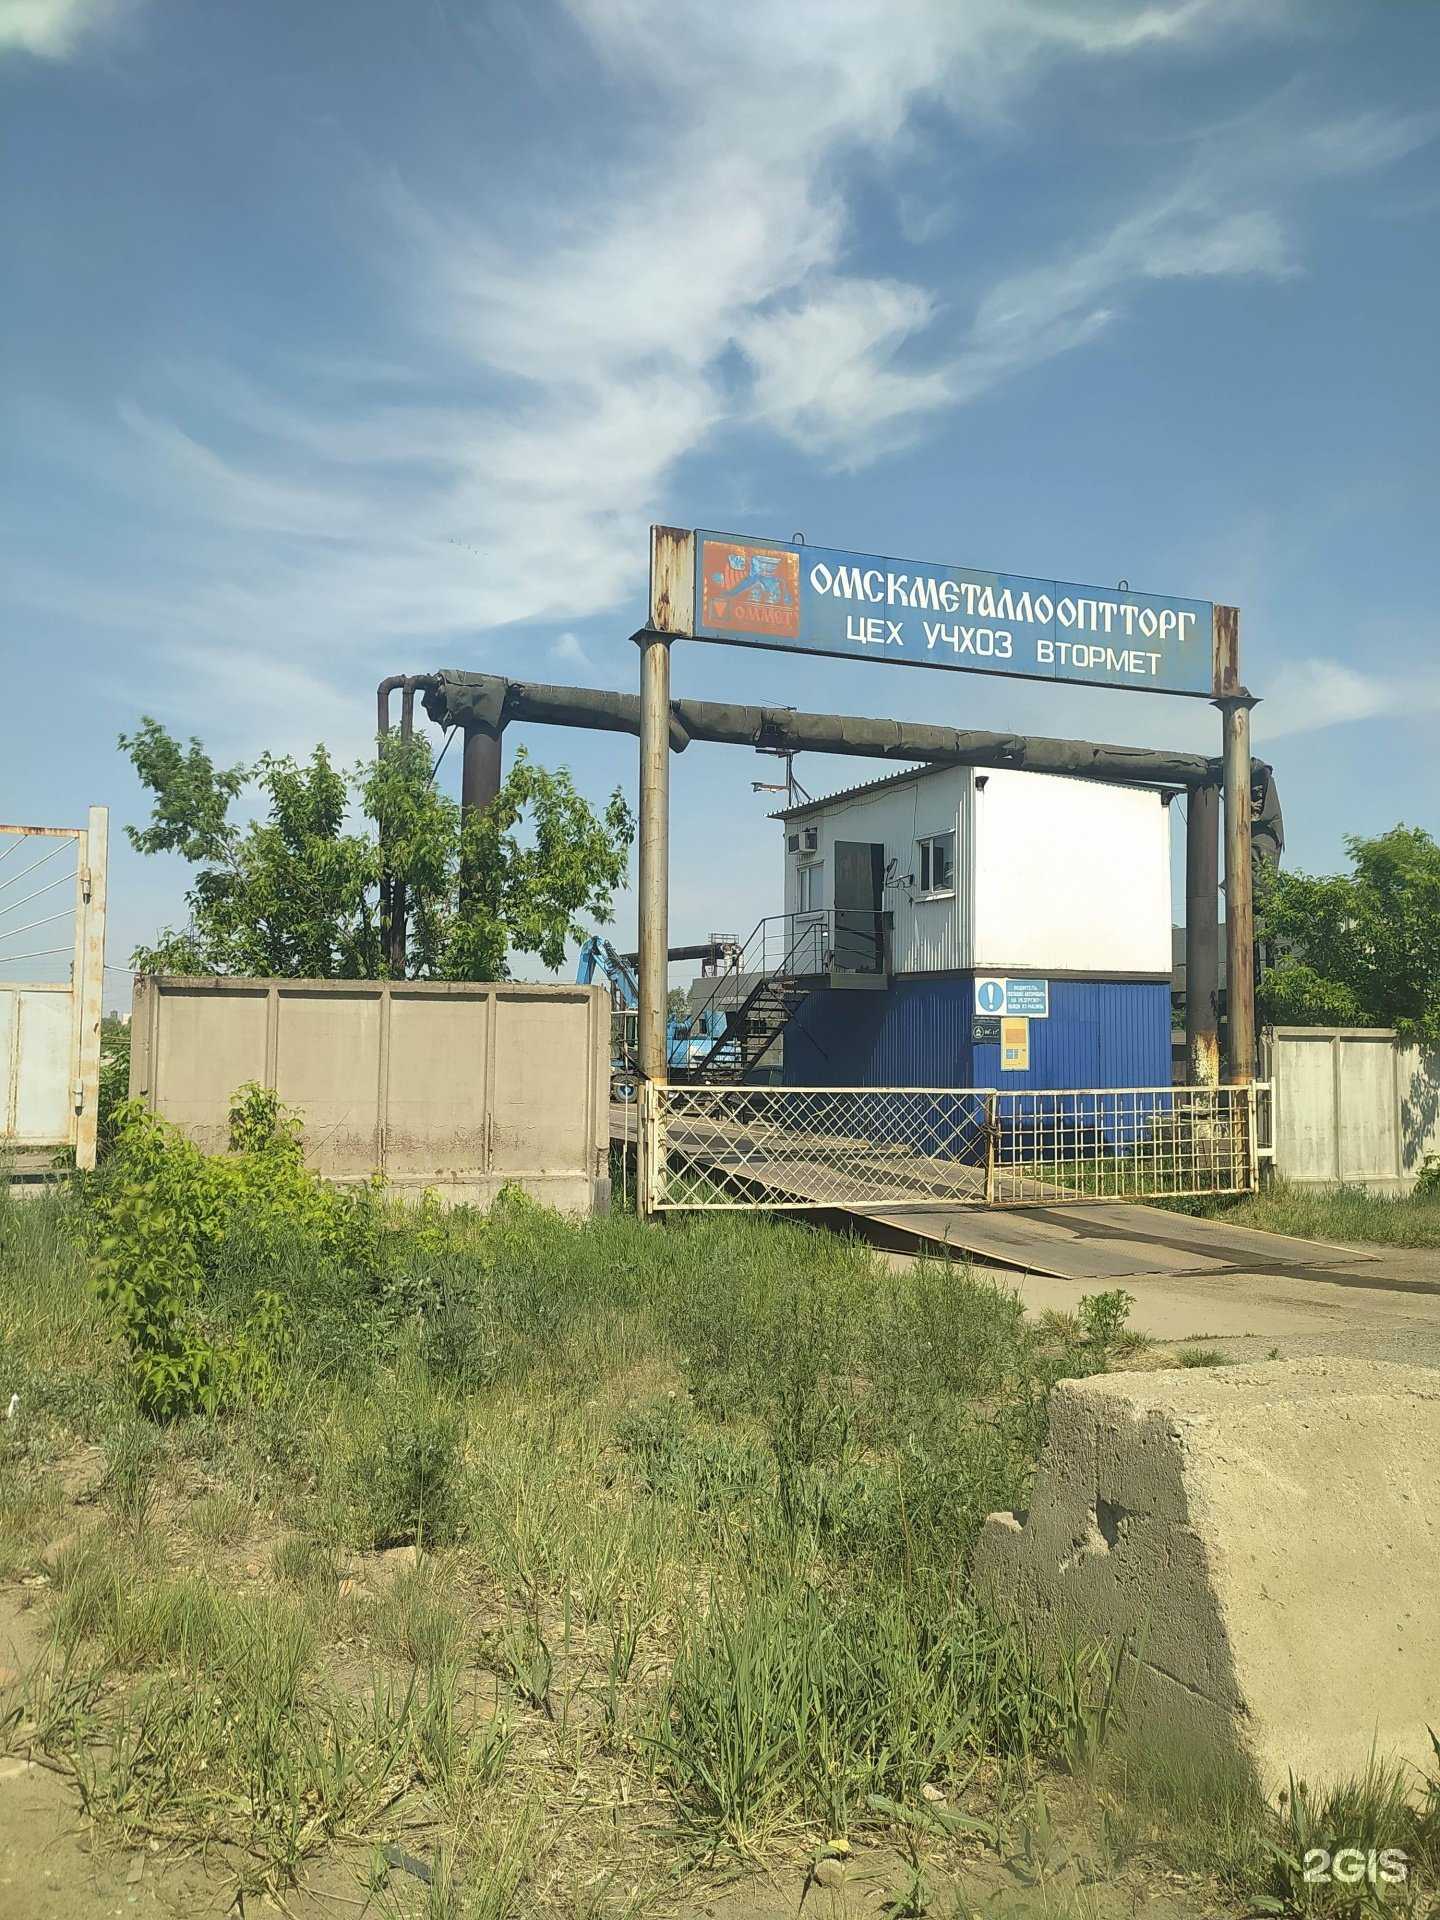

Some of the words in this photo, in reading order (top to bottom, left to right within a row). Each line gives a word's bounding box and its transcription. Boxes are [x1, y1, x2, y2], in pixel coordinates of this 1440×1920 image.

[810, 563, 1196, 641] ОМСКМЕТАЛЛООПТТОРГ
[846, 615, 904, 646] ЦЕХ
[922, 621, 1013, 658] УЧХОЗ
[1036, 639, 1162, 675] ВТОРМЕТ
